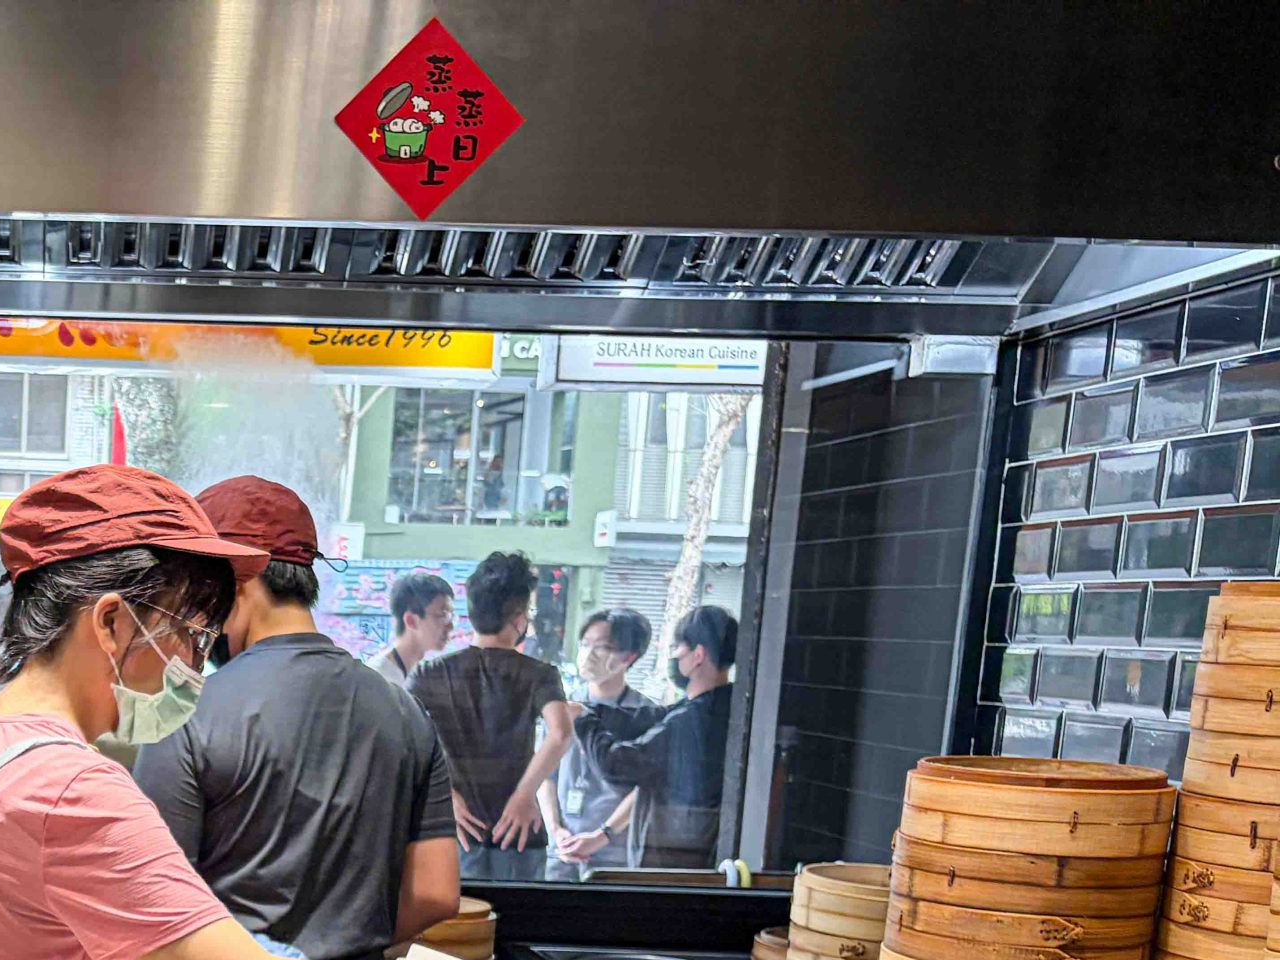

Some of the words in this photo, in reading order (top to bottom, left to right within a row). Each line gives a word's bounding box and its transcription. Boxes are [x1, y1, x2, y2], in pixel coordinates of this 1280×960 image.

[596, 341, 651, 358] SURAH
[655, 343, 705, 359] Korean
[708, 345, 759, 361] Cuisine
